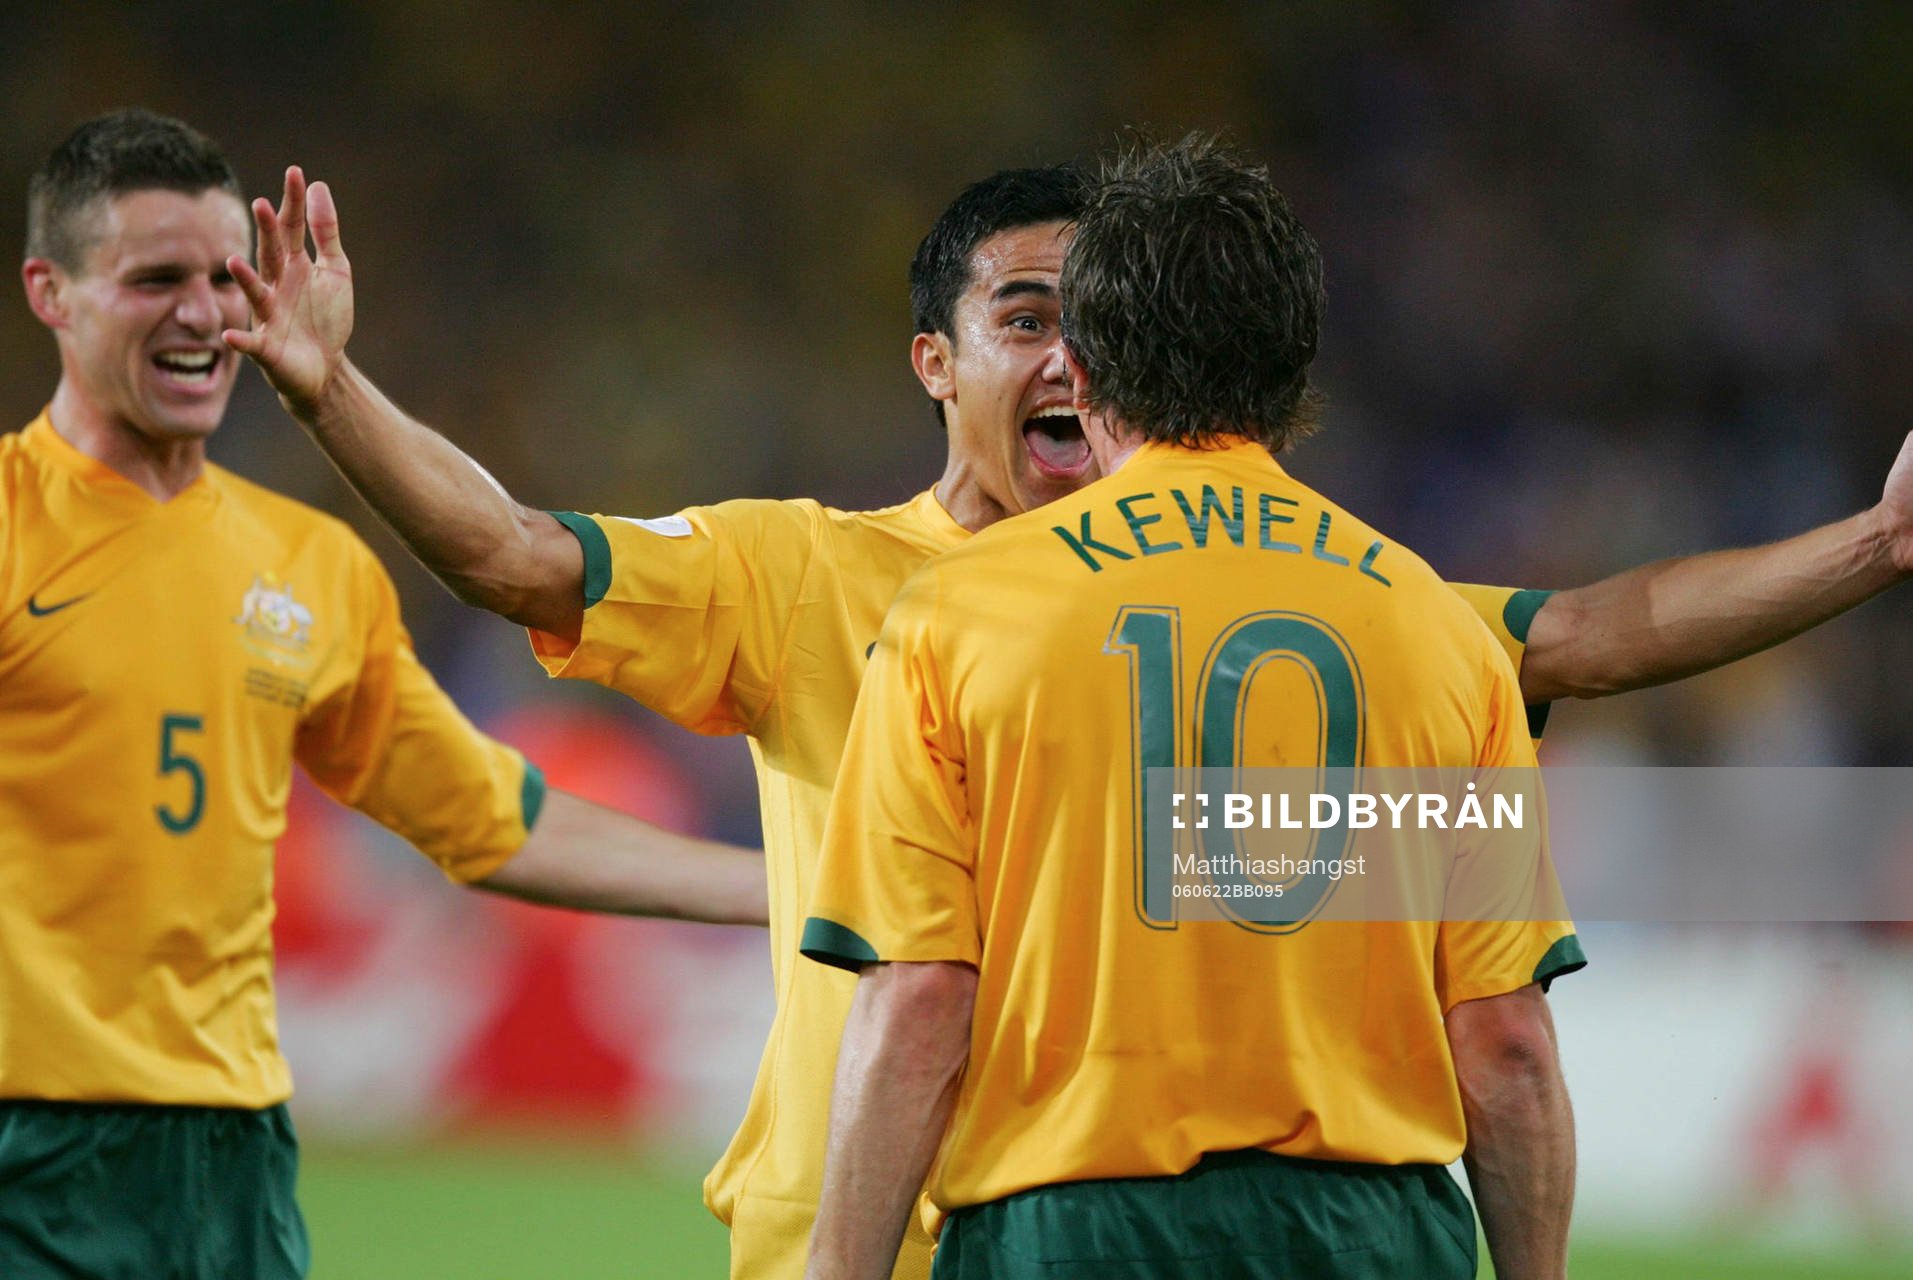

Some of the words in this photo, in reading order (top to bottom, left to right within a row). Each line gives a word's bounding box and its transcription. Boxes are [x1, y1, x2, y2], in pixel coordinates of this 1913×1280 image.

[1052, 484, 1392, 588] KEWELL
[156, 713, 206, 835] 5
[1102, 605, 1367, 936] 10
